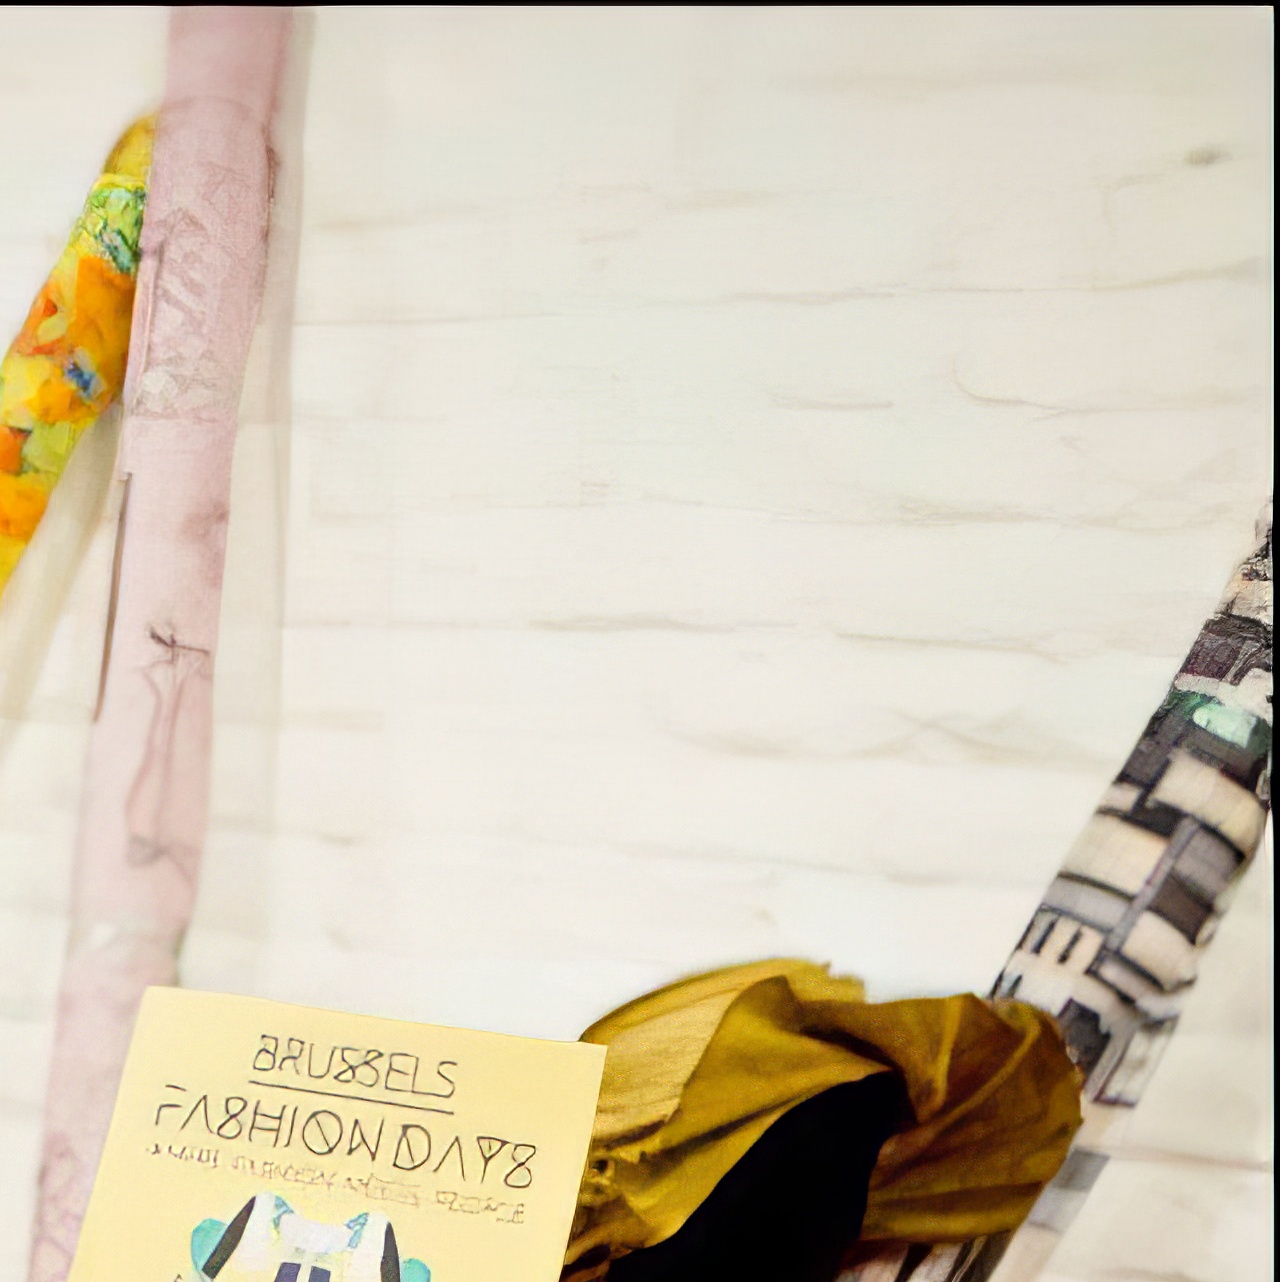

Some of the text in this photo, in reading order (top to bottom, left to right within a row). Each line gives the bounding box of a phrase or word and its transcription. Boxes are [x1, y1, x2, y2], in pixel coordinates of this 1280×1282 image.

[252, 1033, 458, 1099] BRUSSELS
[154, 1083, 381, 1163] FASHION
[394, 1123, 538, 1190] DAYS
